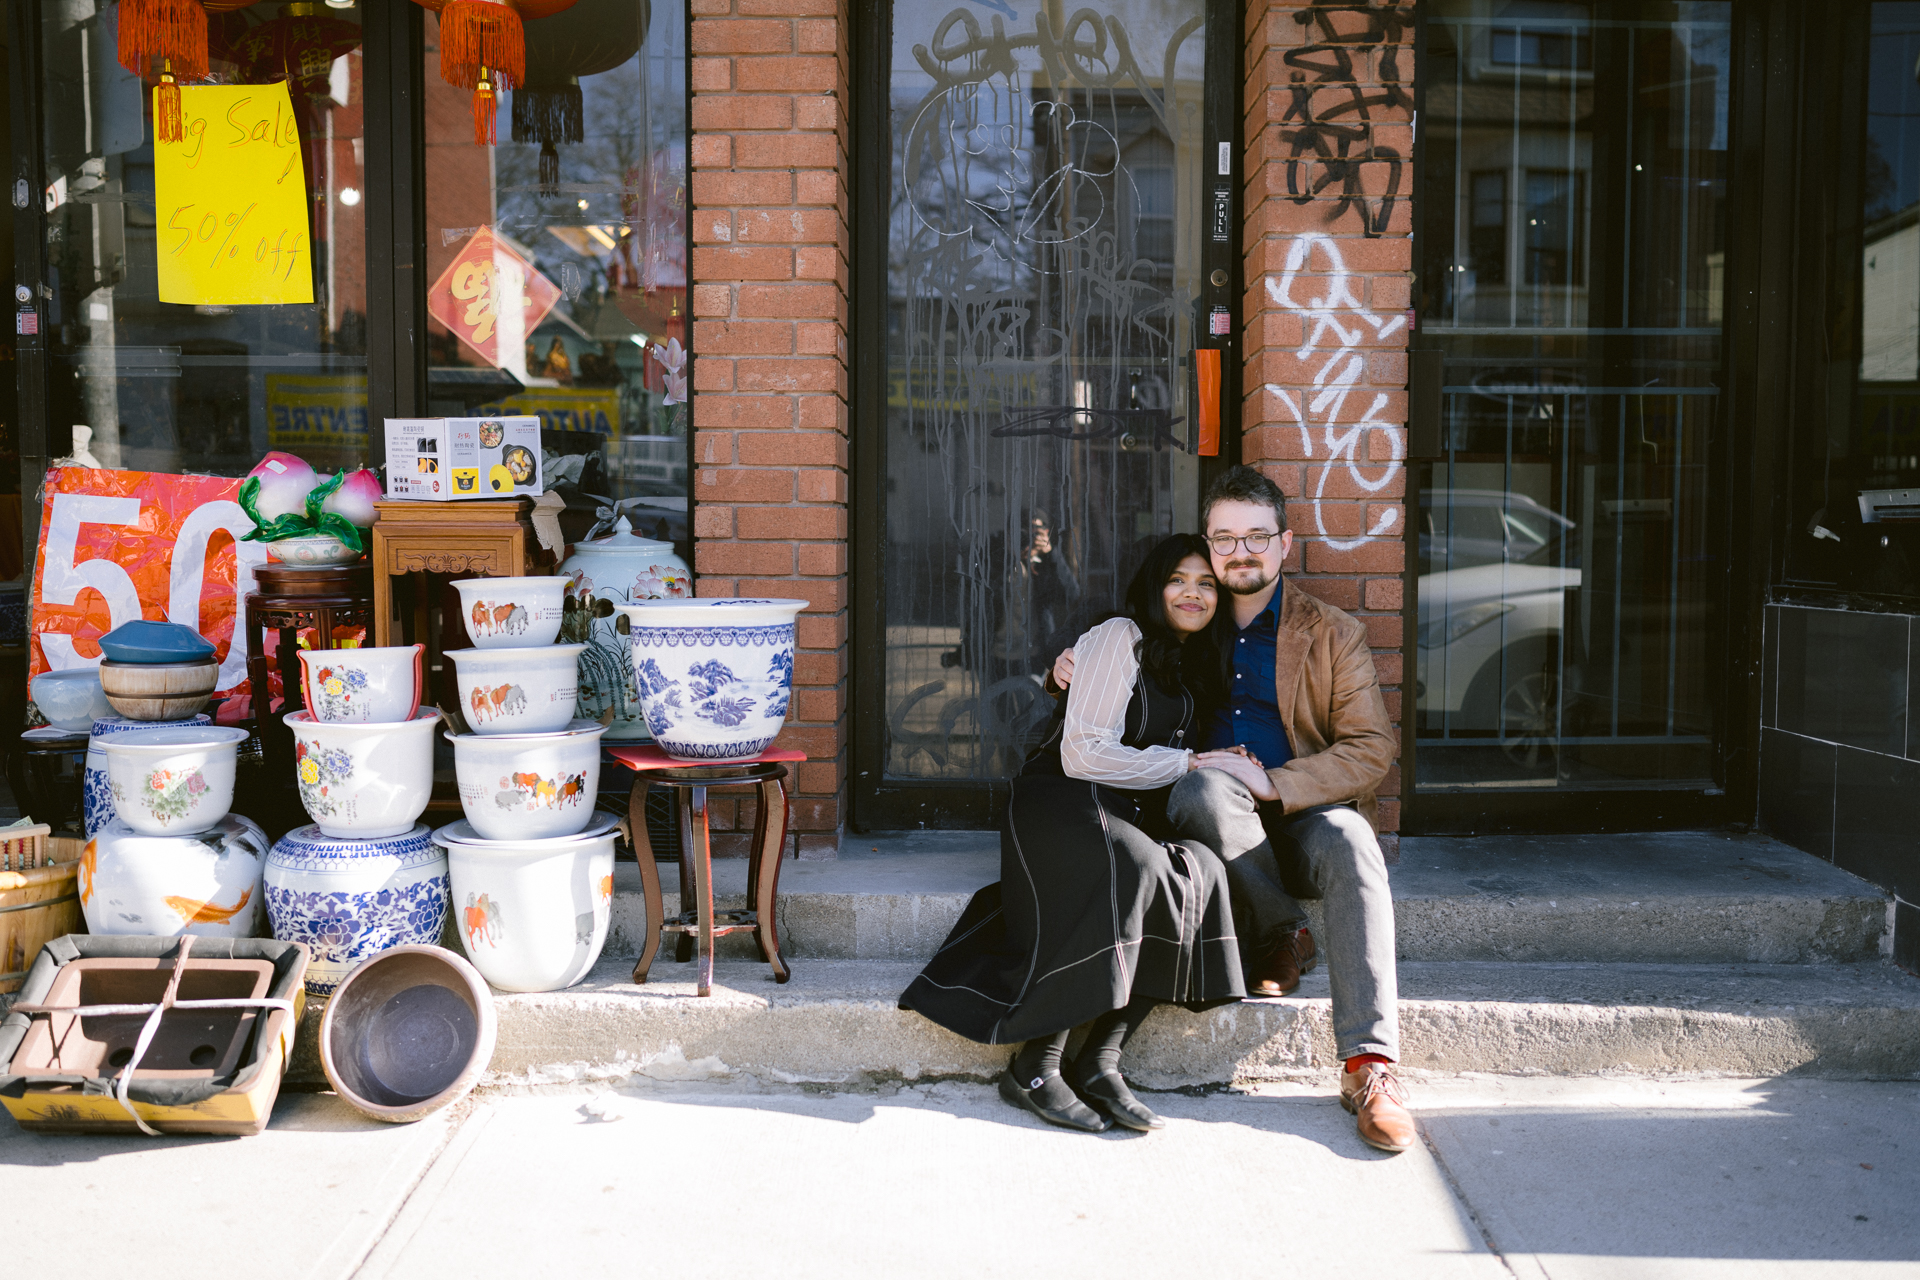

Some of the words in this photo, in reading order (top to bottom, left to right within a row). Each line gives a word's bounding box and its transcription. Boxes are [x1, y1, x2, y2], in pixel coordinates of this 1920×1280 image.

[160, 109, 208, 169] ig
[226, 96, 298, 149] Sale
[168, 202, 258, 270] 50%
[40, 493, 269, 692] 50
